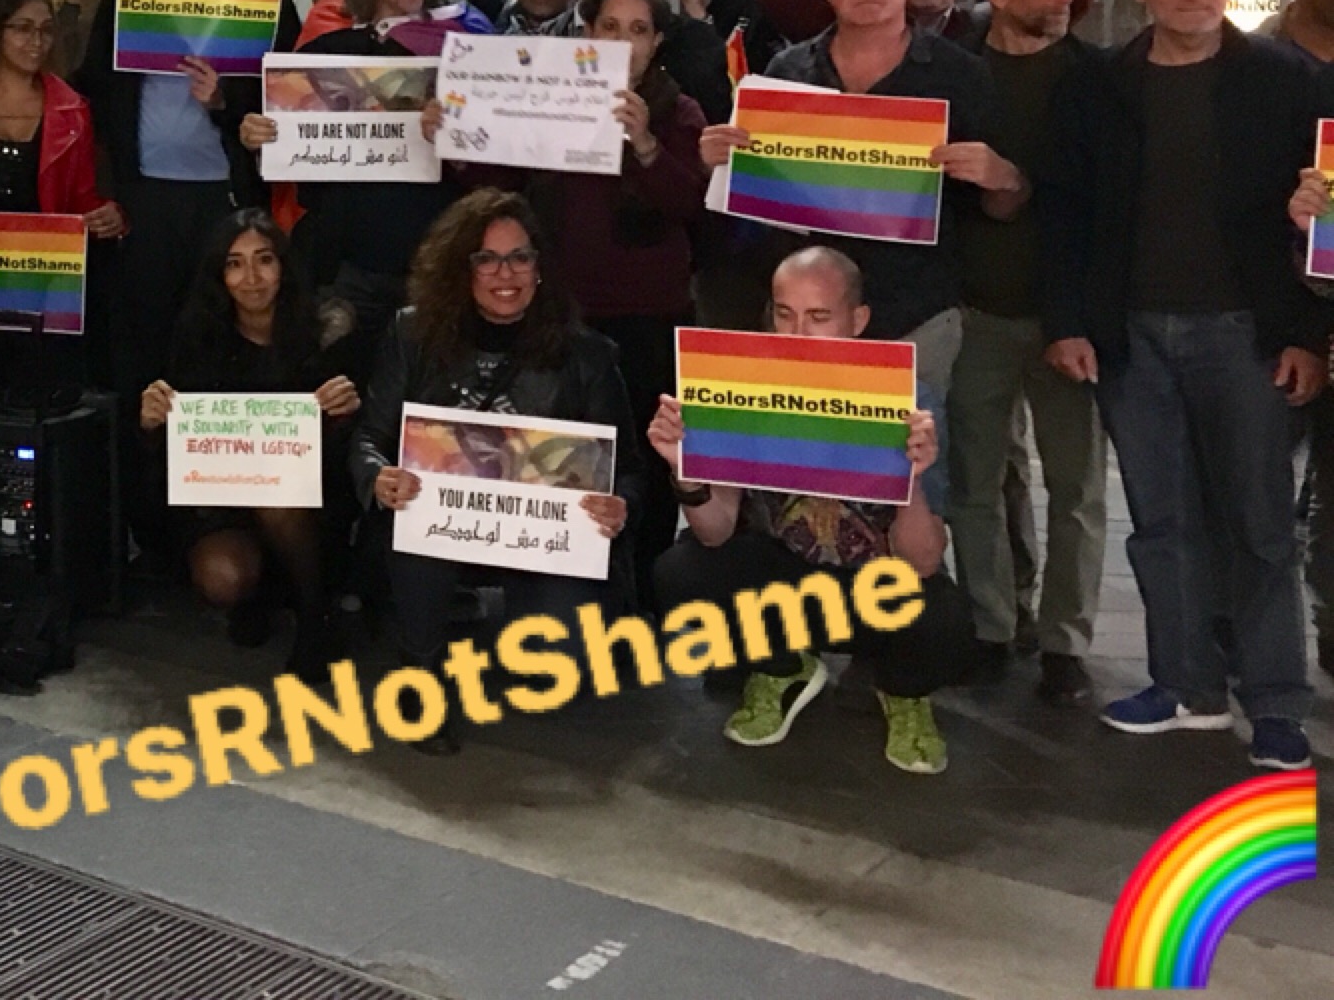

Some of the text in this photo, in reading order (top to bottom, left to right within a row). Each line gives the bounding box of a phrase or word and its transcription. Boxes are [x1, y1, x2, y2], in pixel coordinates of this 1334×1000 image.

[298, 123, 405, 139] YOU ARE NOT ALONE
[180, 398, 205, 415] WE
[212, 399, 239, 415] ARE
[683, 387, 911, 421] #ColorsRNotShame
[177, 420, 189, 435] IN
[261, 422, 298, 436] WITH
[438, 487, 568, 522] YOU ARE NOT ALONE
